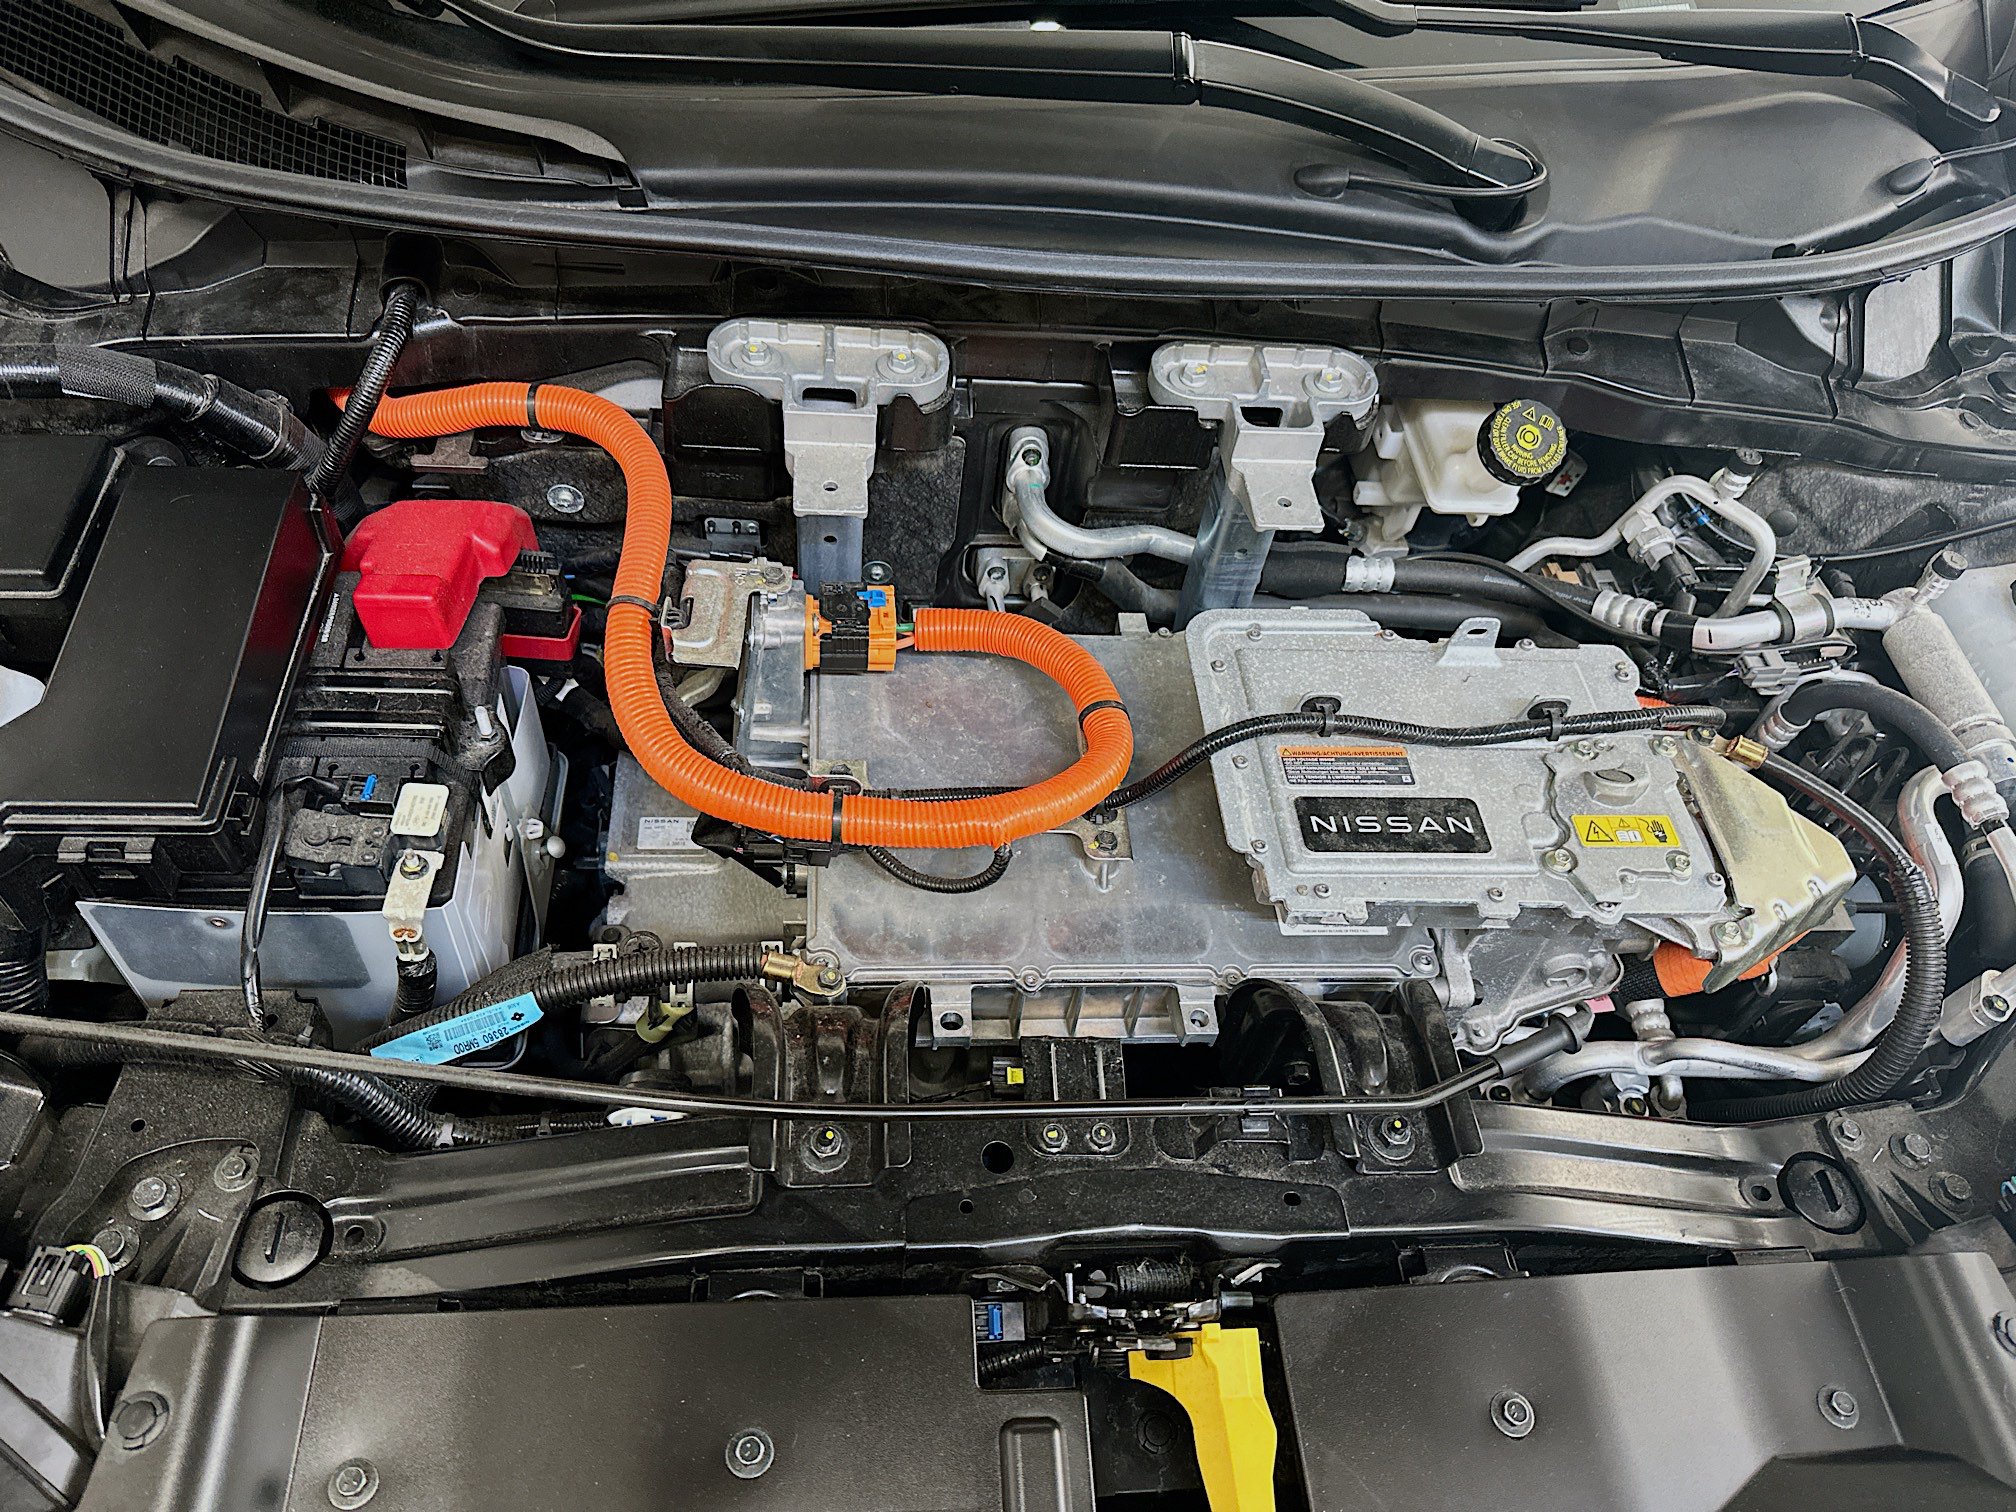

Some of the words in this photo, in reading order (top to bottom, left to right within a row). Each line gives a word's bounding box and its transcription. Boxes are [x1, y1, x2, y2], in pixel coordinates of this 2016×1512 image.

[1511, 443, 1533, 459] WARNING
[1310, 815, 1475, 834] NISSAN
[482, 1026, 510, 1044] 28360
